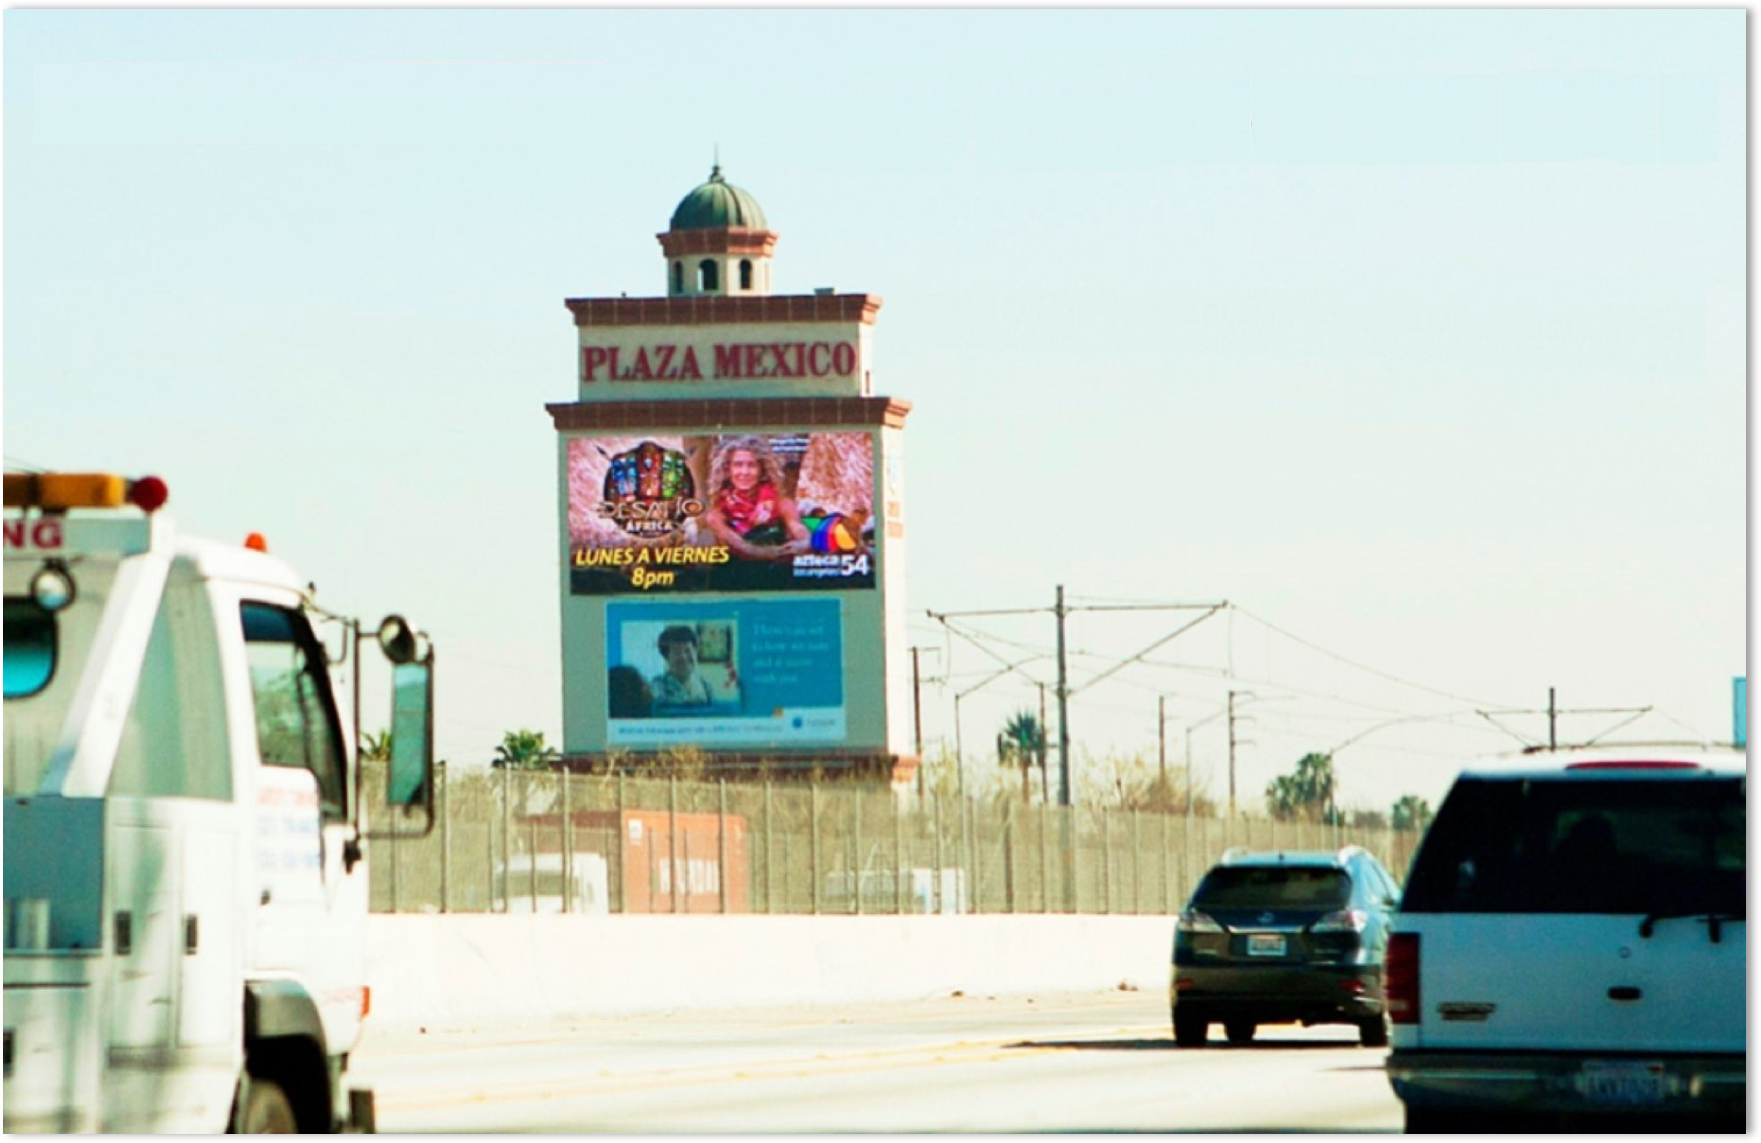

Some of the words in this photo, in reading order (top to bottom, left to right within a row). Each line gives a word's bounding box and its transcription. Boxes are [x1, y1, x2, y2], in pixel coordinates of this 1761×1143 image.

[583, 345, 703, 381] PLAZA
[713, 342, 856, 379] MEXICO
[576, 549, 633, 566] LUNES
[636, 548, 650, 563] A
[654, 546, 729, 564] VIERNES
[841, 554, 868, 576] 54
[631, 566, 674, 589] 8pm
